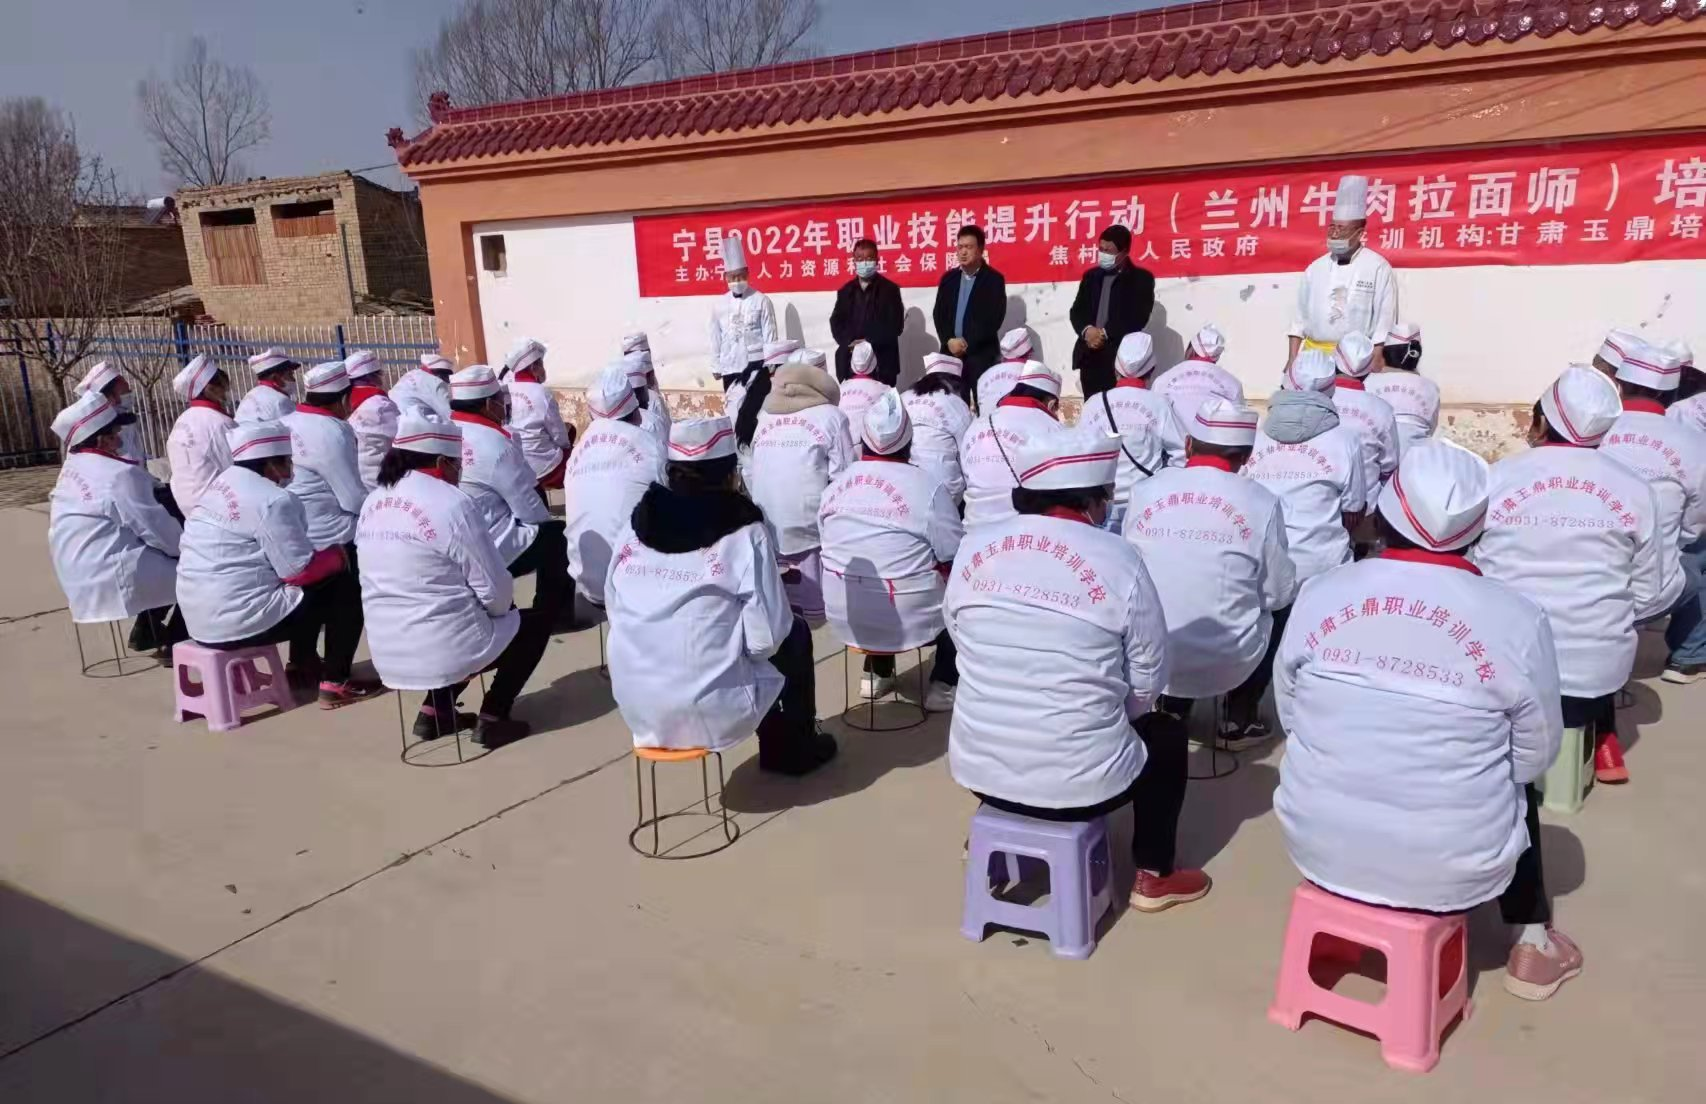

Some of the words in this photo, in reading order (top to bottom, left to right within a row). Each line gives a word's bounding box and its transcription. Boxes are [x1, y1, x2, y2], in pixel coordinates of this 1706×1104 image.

[1049, 235, 1260, 265] 焦村人民政府
[1491, 476, 1634, 527] 甘肃玉鼎职业培训学校
[1145, 527, 1233, 545] 0931-8728533
[1504, 515, 1615, 529] 0931-8728533
[961, 534, 1106, 605] 甘肃玉鼎职业培训学校
[972, 578, 1081, 608] 0931-8728533
[1304, 596, 1496, 683] 甘肃玉鼎职业培训学校
[1322, 647, 1464, 687] 0931-8728533
